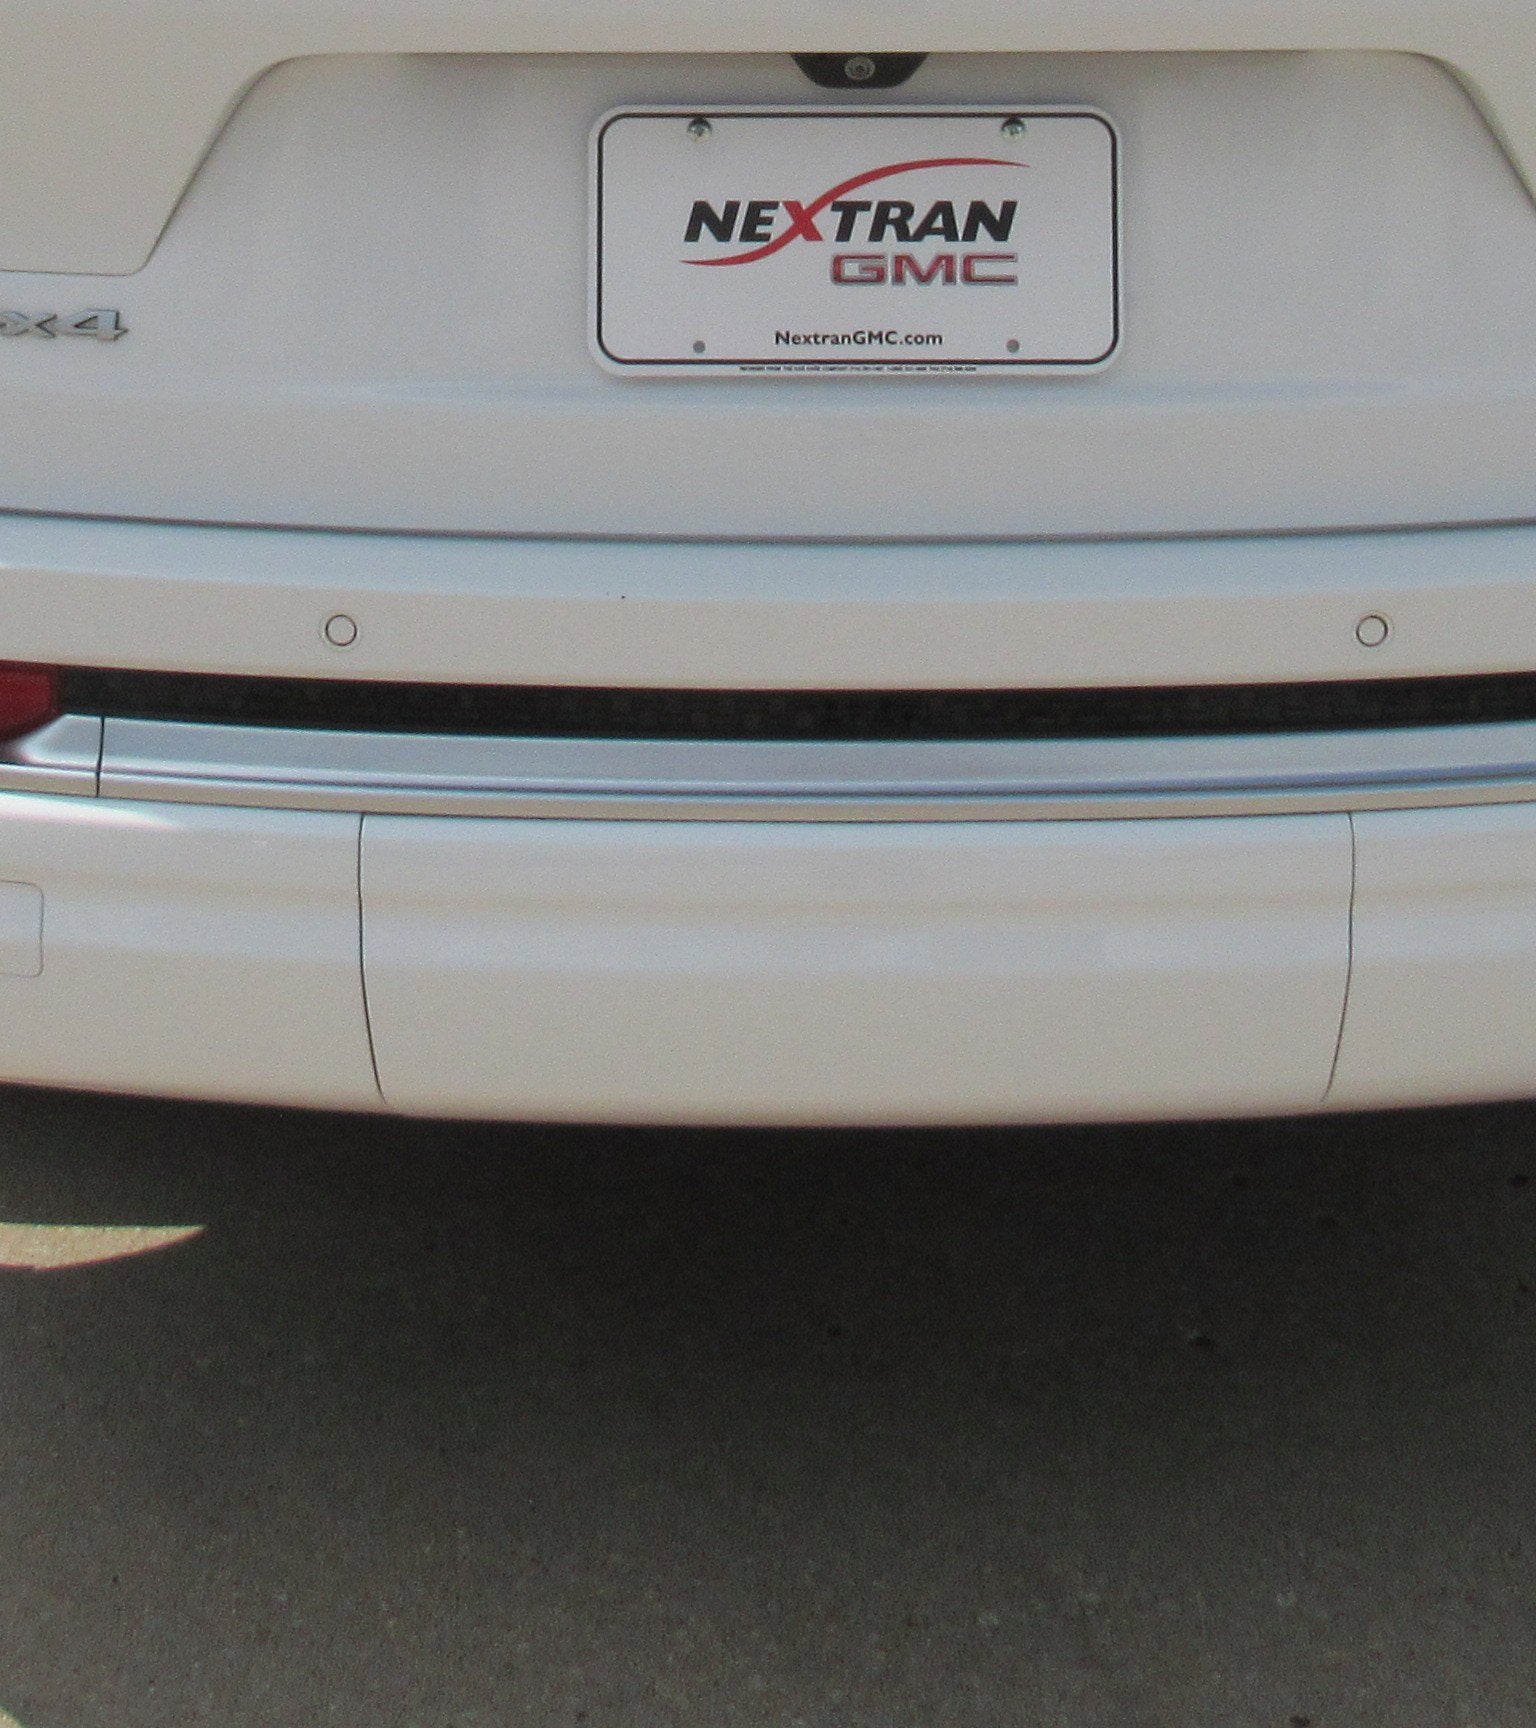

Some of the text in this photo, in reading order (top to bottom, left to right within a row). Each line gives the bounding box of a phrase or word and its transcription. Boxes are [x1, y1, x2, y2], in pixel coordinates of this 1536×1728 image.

[683, 199, 1020, 243] NEXTRAN
[829, 252, 1020, 287] GMC
[773, 328, 944, 347] NextranGMC.com
